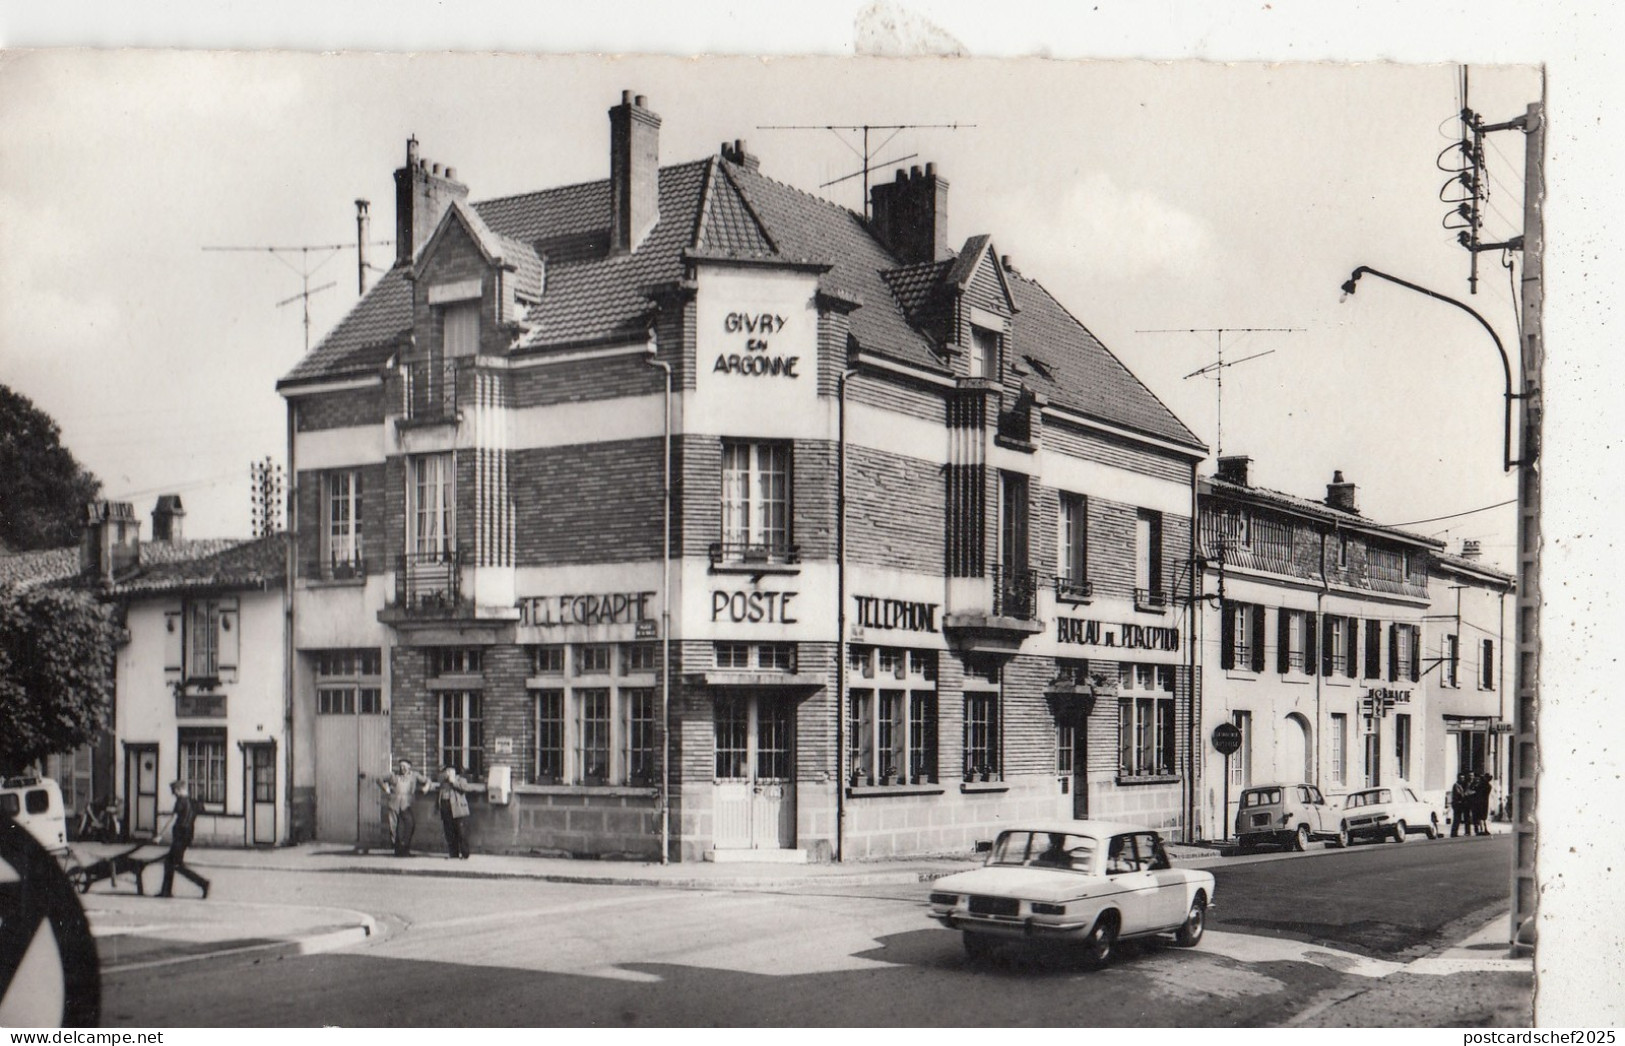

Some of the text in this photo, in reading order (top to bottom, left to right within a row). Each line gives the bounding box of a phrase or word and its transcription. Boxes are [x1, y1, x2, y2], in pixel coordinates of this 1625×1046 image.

[724, 312, 788, 334] GIVRY
[713, 353, 800, 379] ARGONNE
[711, 590, 799, 624] POSTE
[1057, 617, 1100, 645] BUREAU
[1121, 624, 1179, 652] PERCEPTION
